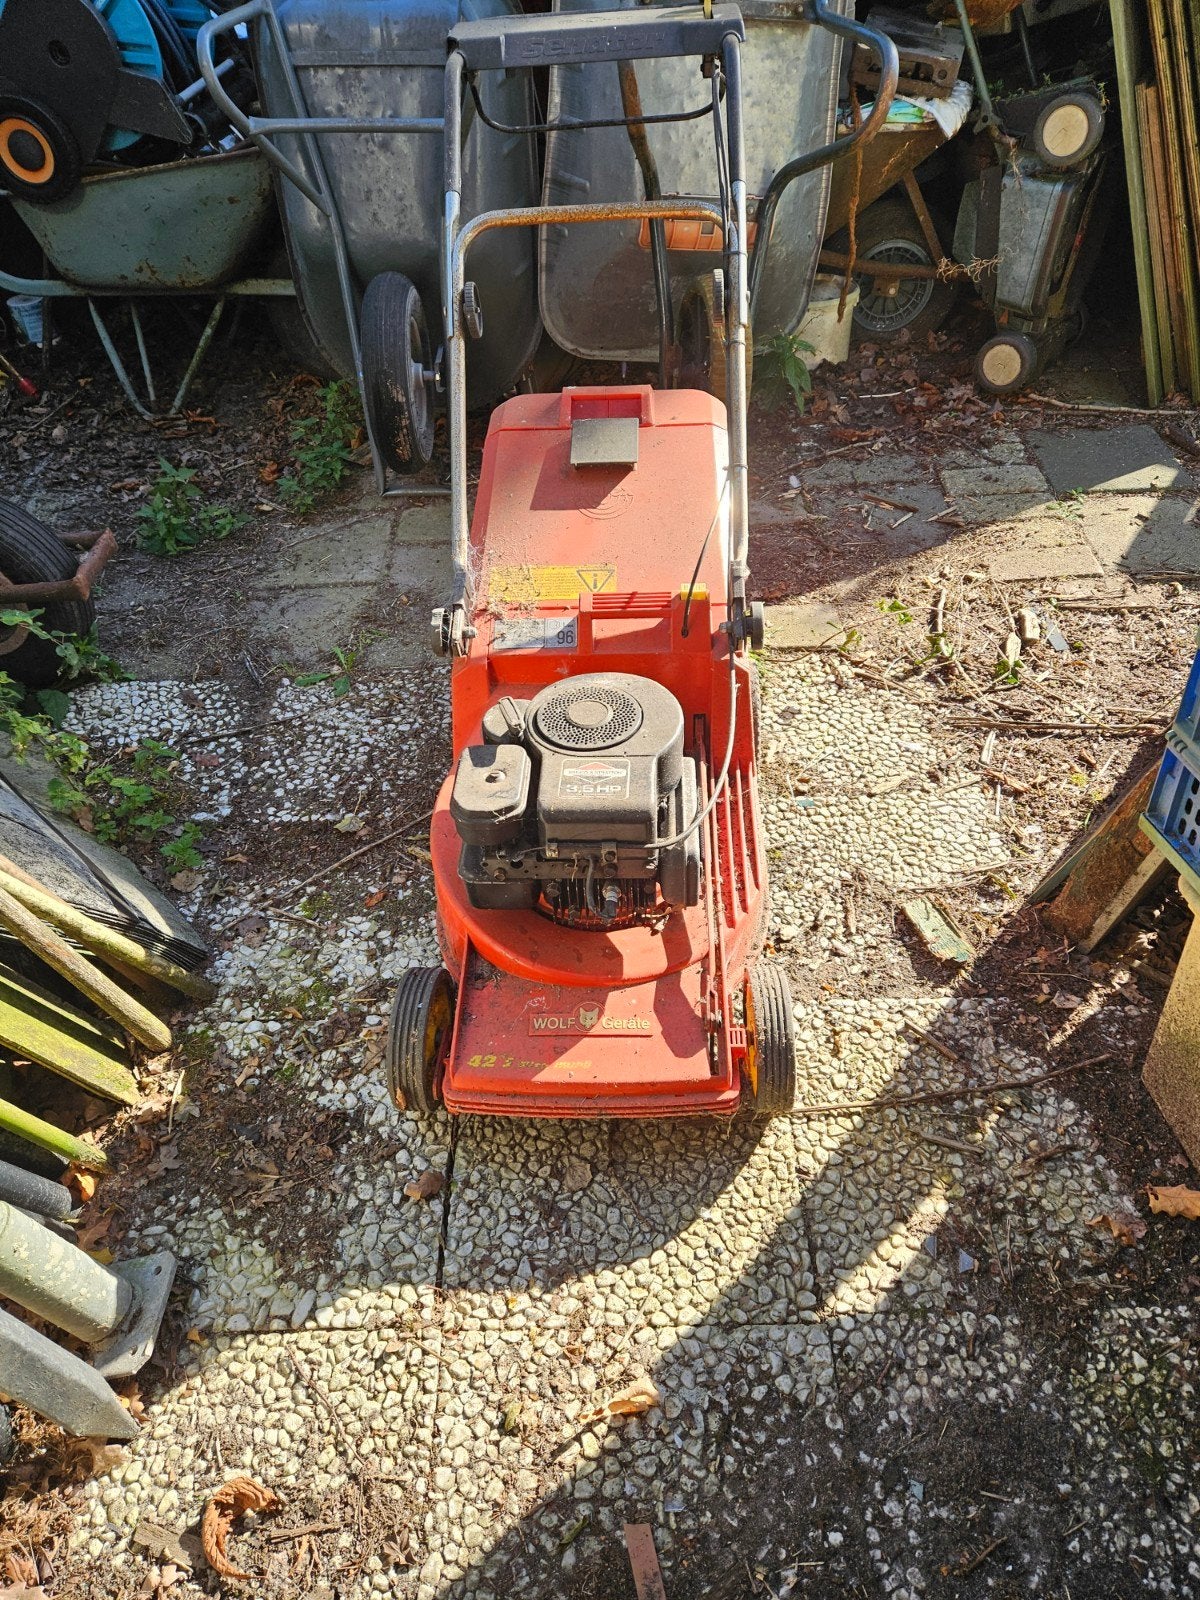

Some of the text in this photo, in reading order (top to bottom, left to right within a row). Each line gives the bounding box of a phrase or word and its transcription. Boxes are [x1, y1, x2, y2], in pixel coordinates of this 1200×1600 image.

[557, 629, 574, 645] 96
[533, 1017, 651, 1030] WOLF Geräte
[467, 1054, 497, 1068] 42
